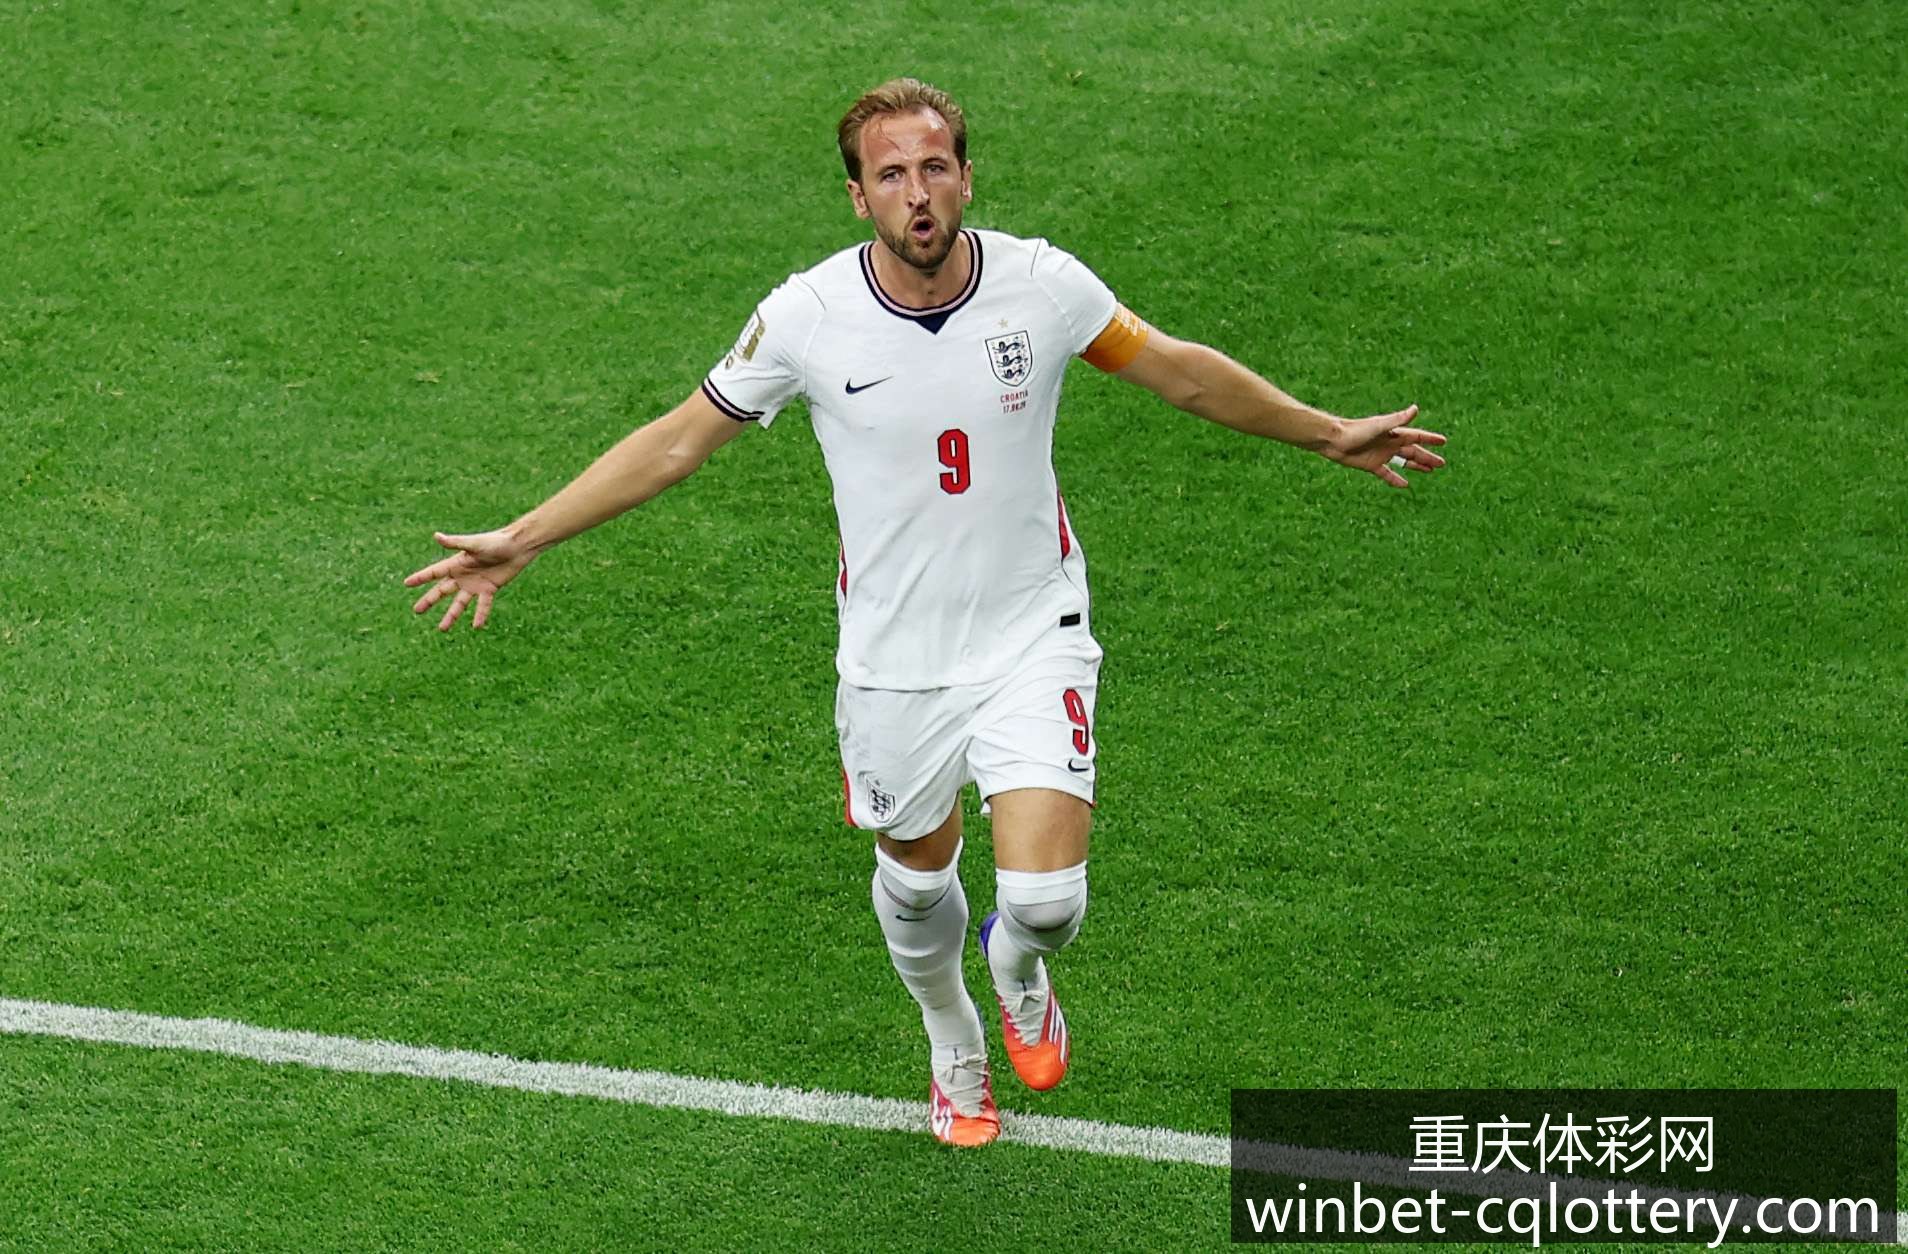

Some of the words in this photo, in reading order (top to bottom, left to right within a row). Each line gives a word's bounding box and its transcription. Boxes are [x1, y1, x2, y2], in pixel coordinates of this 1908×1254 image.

[1000, 390, 1028, 403] CROATIA
[937, 428, 971, 495] 9
[1062, 688, 1089, 756] 9
